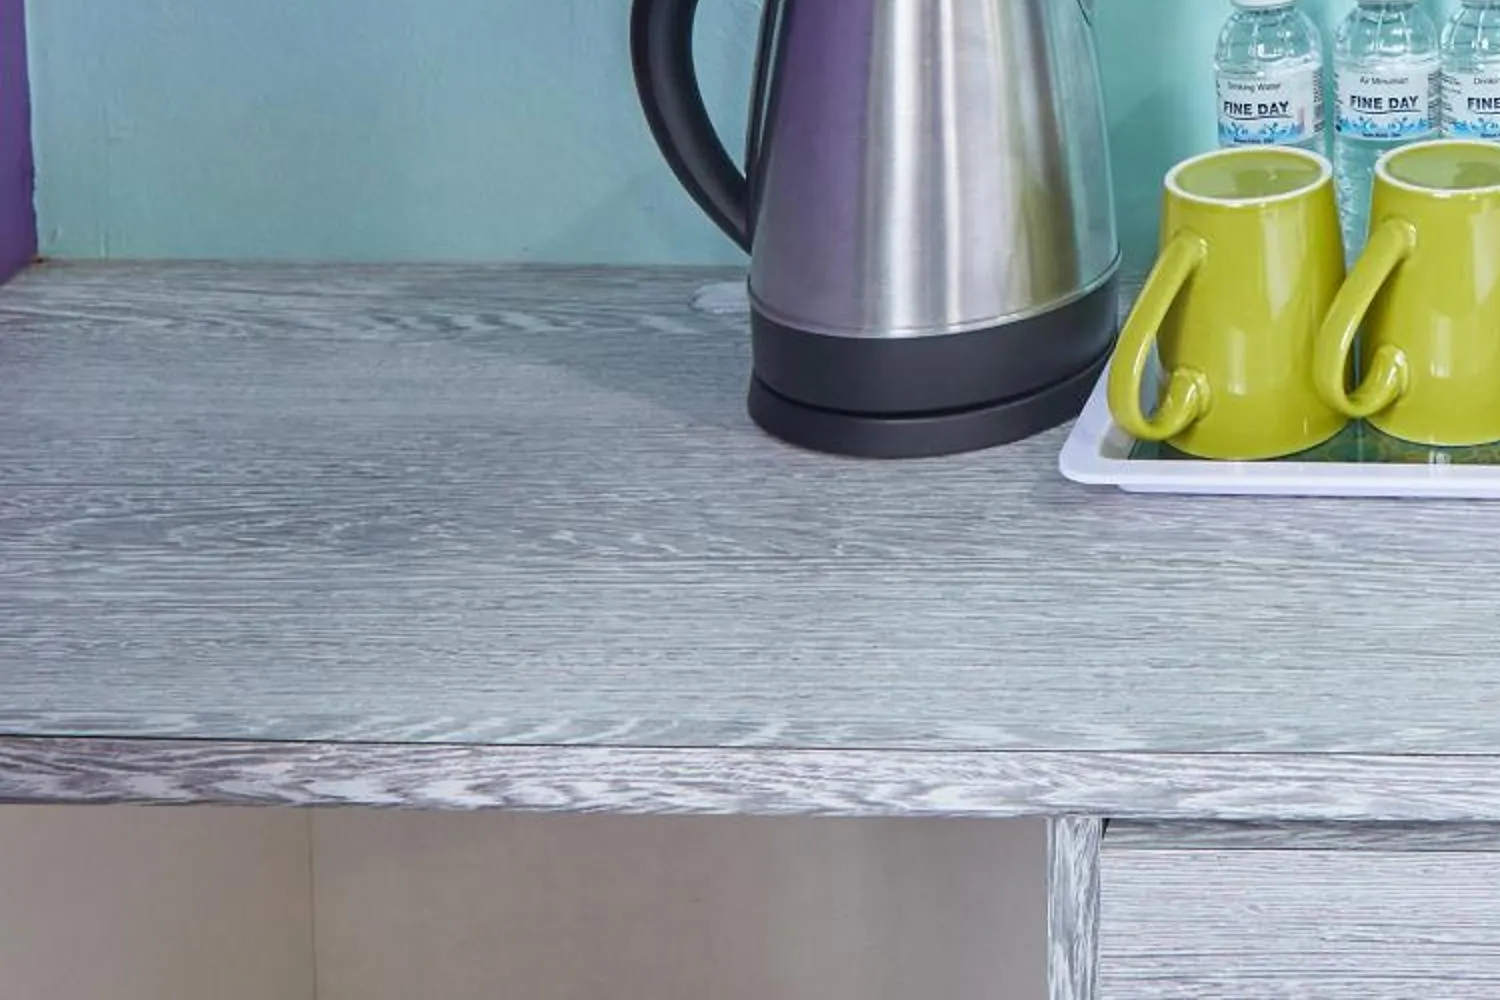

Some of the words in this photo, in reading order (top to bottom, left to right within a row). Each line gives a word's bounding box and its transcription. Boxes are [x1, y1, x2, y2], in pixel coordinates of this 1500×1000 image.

[1223, 100, 1253, 116] FINE
[1257, 100, 1290, 115] DAY
[1349, 95, 1384, 110] FINE
[1387, 94, 1420, 109] DAY
